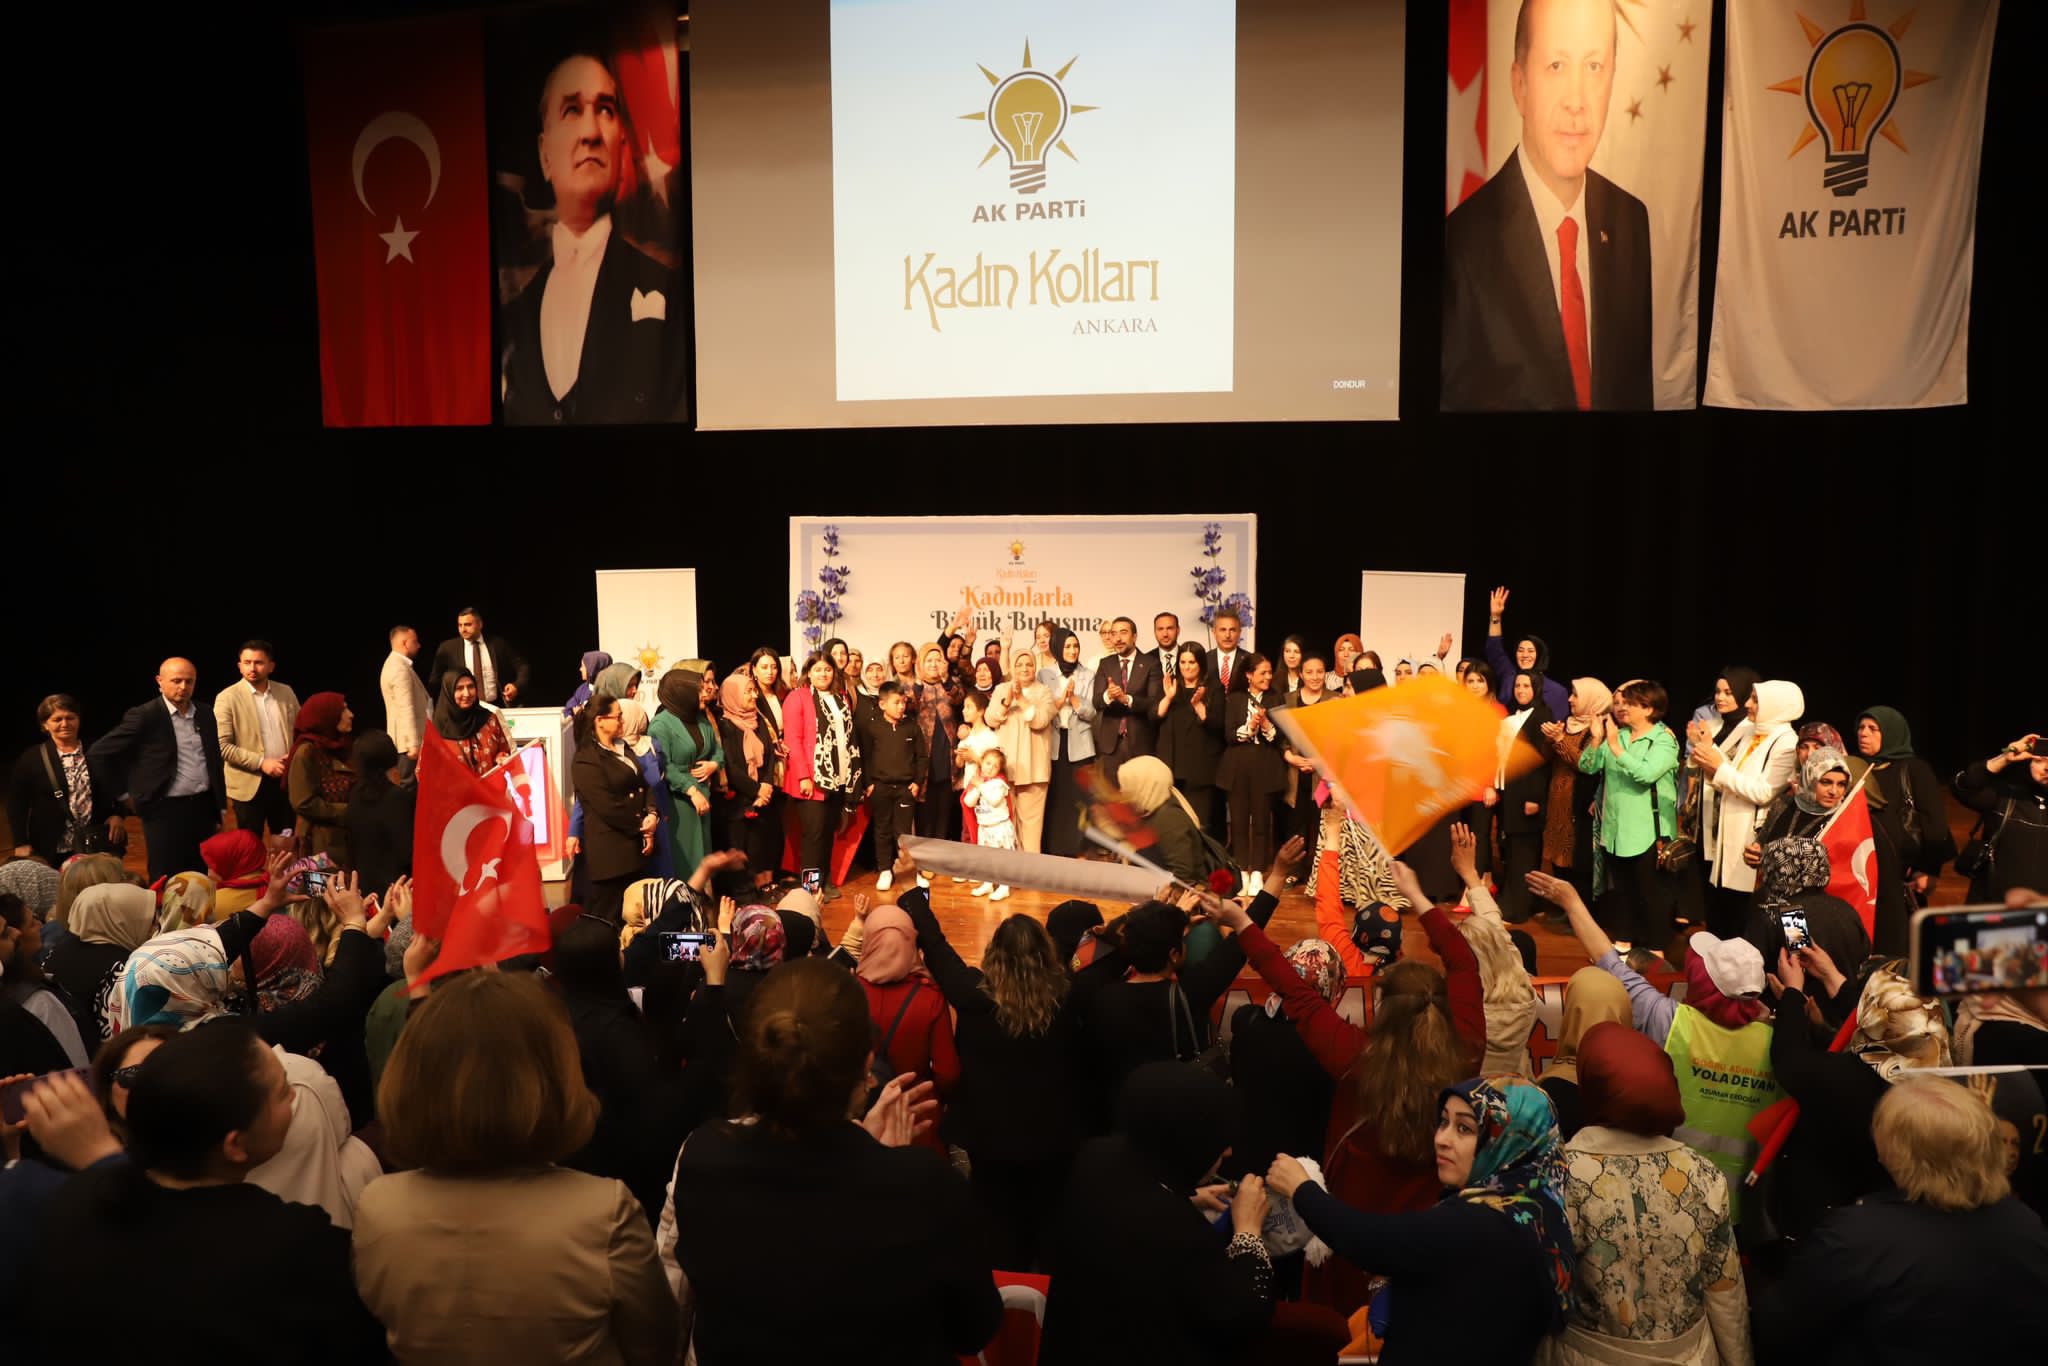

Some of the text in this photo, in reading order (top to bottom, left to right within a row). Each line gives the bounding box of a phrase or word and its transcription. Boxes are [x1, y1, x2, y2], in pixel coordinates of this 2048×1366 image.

[972, 204, 1007, 223] AK
[1778, 210, 1819, 239] AK
[903, 248, 1160, 333] Kadın Kolları
[1072, 317, 1159, 335] ANKARA
[960, 585, 1073, 609] Kadınlarla
[1691, 1065, 1729, 1084] YOLA
